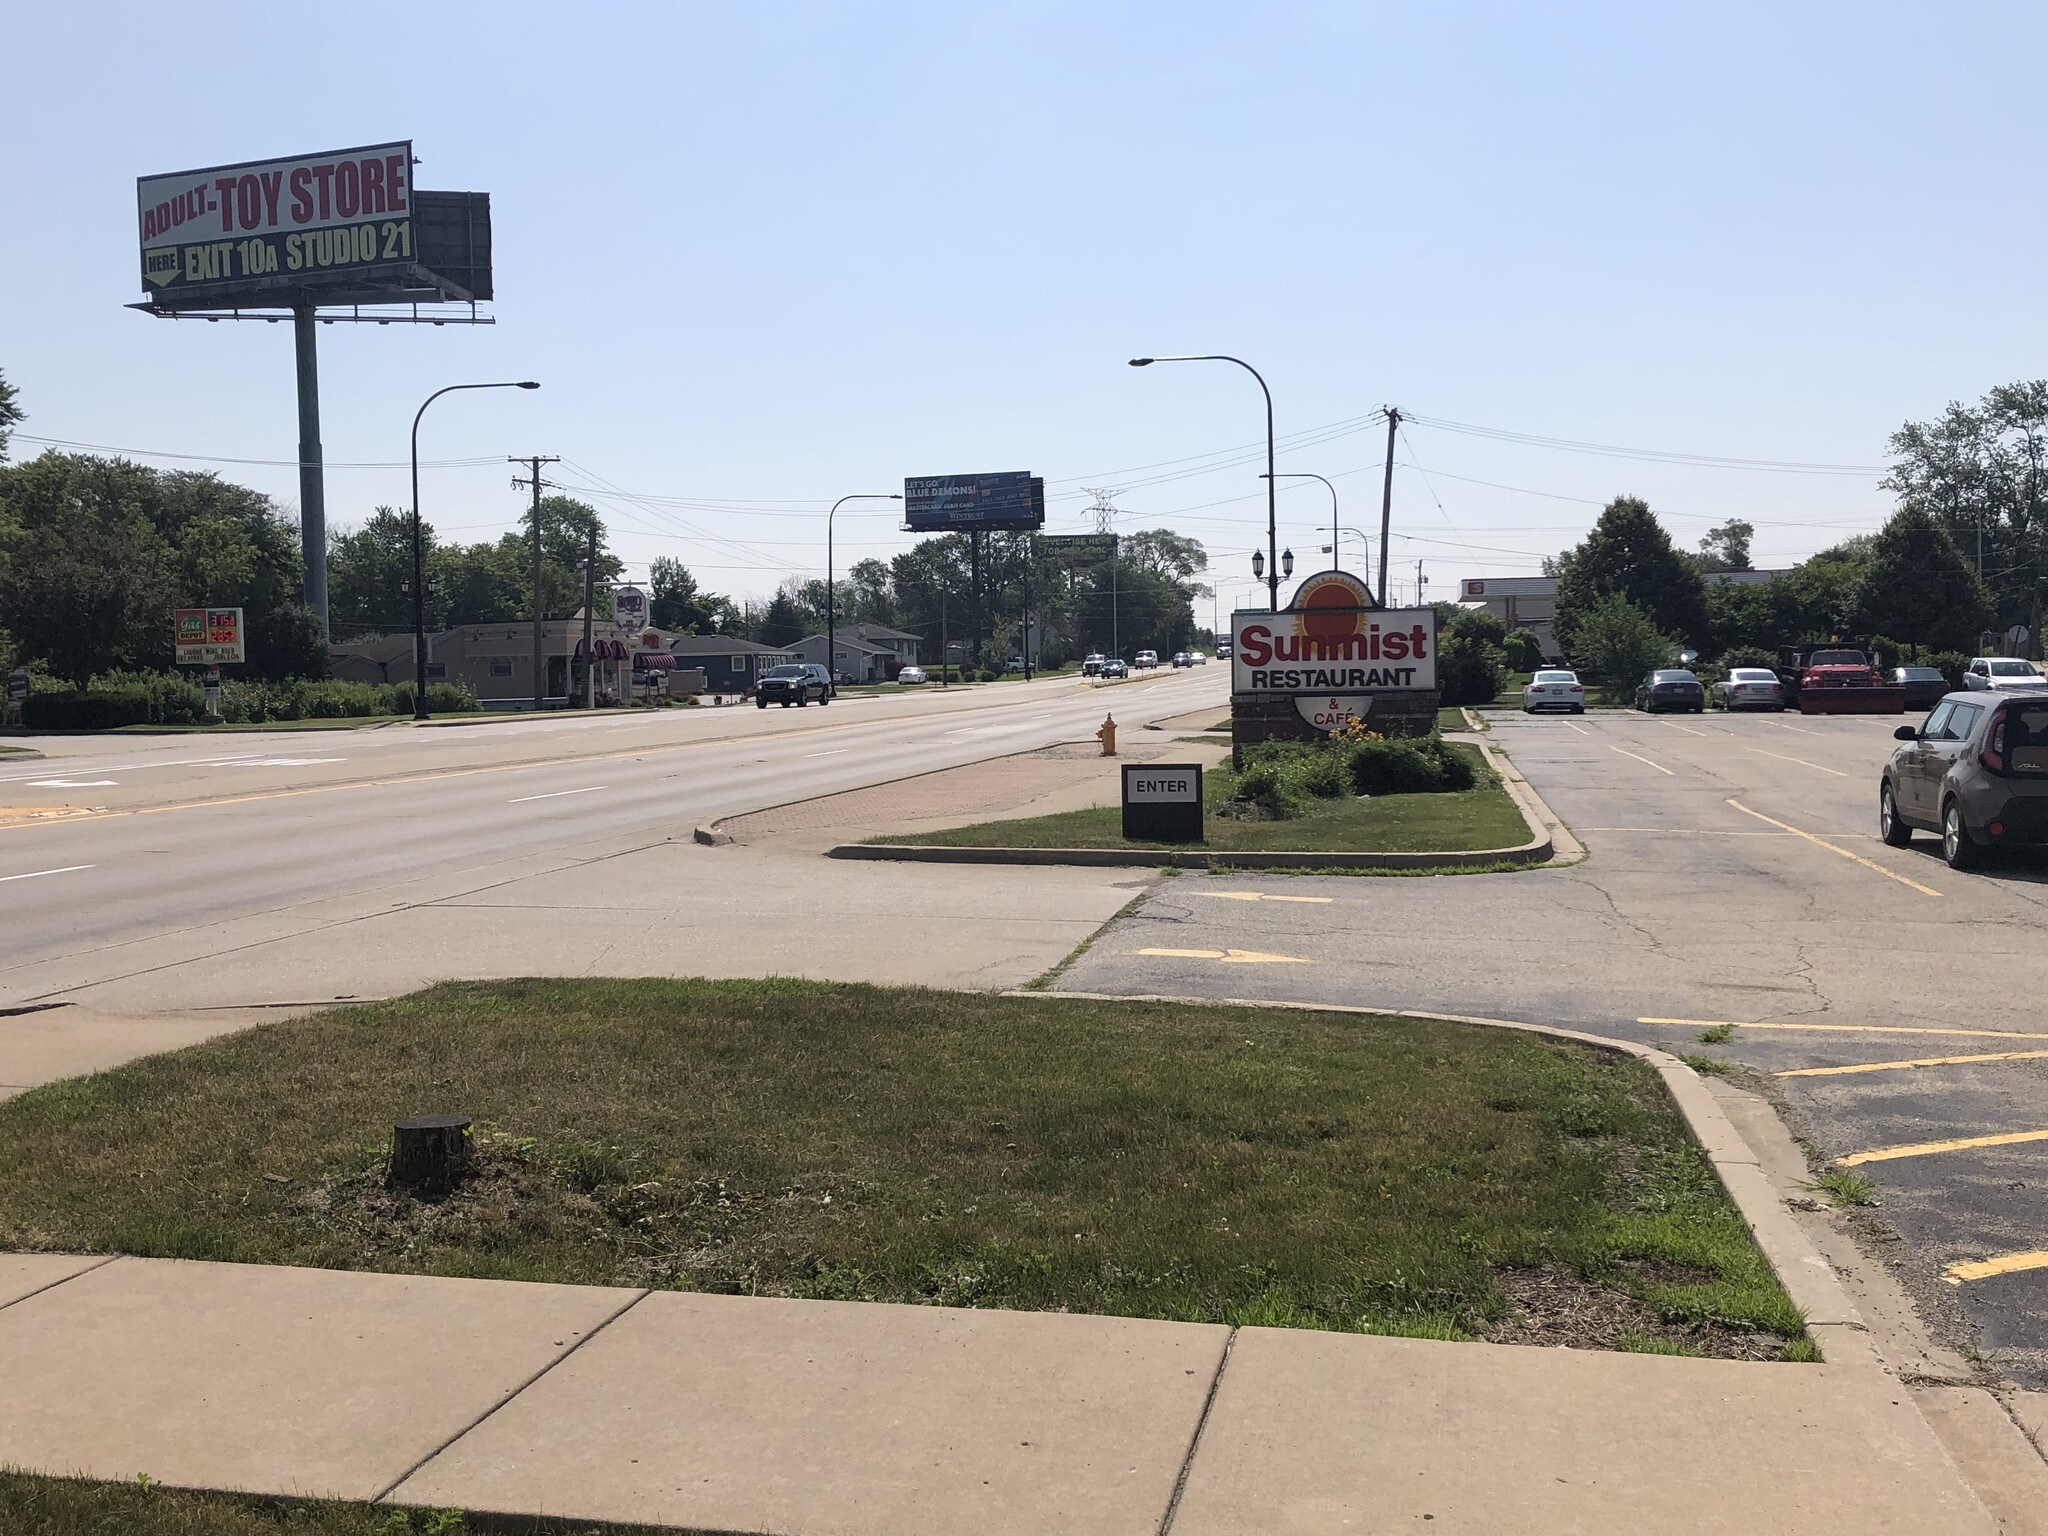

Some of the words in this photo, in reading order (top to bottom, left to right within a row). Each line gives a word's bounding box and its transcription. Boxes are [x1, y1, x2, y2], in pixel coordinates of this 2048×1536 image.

[290, 155, 405, 224] STORE
[185, 242, 234, 281] EXIT
[237, 238, 279, 276] 10A
[286, 224, 376, 271] STUDIO
[381, 221, 411, 260] 21
[148, 253, 176, 273] HERE
[906, 480, 925, 489] LET'S
[906, 488, 930, 498] BLUE
[932, 485, 976, 497] DEMONS!
[1239, 623, 1427, 667] Sunmist
[1251, 667, 1416, 689] RESTAURANT
[1328, 697, 1339, 710] &
[1136, 780, 1188, 793] ENTER
